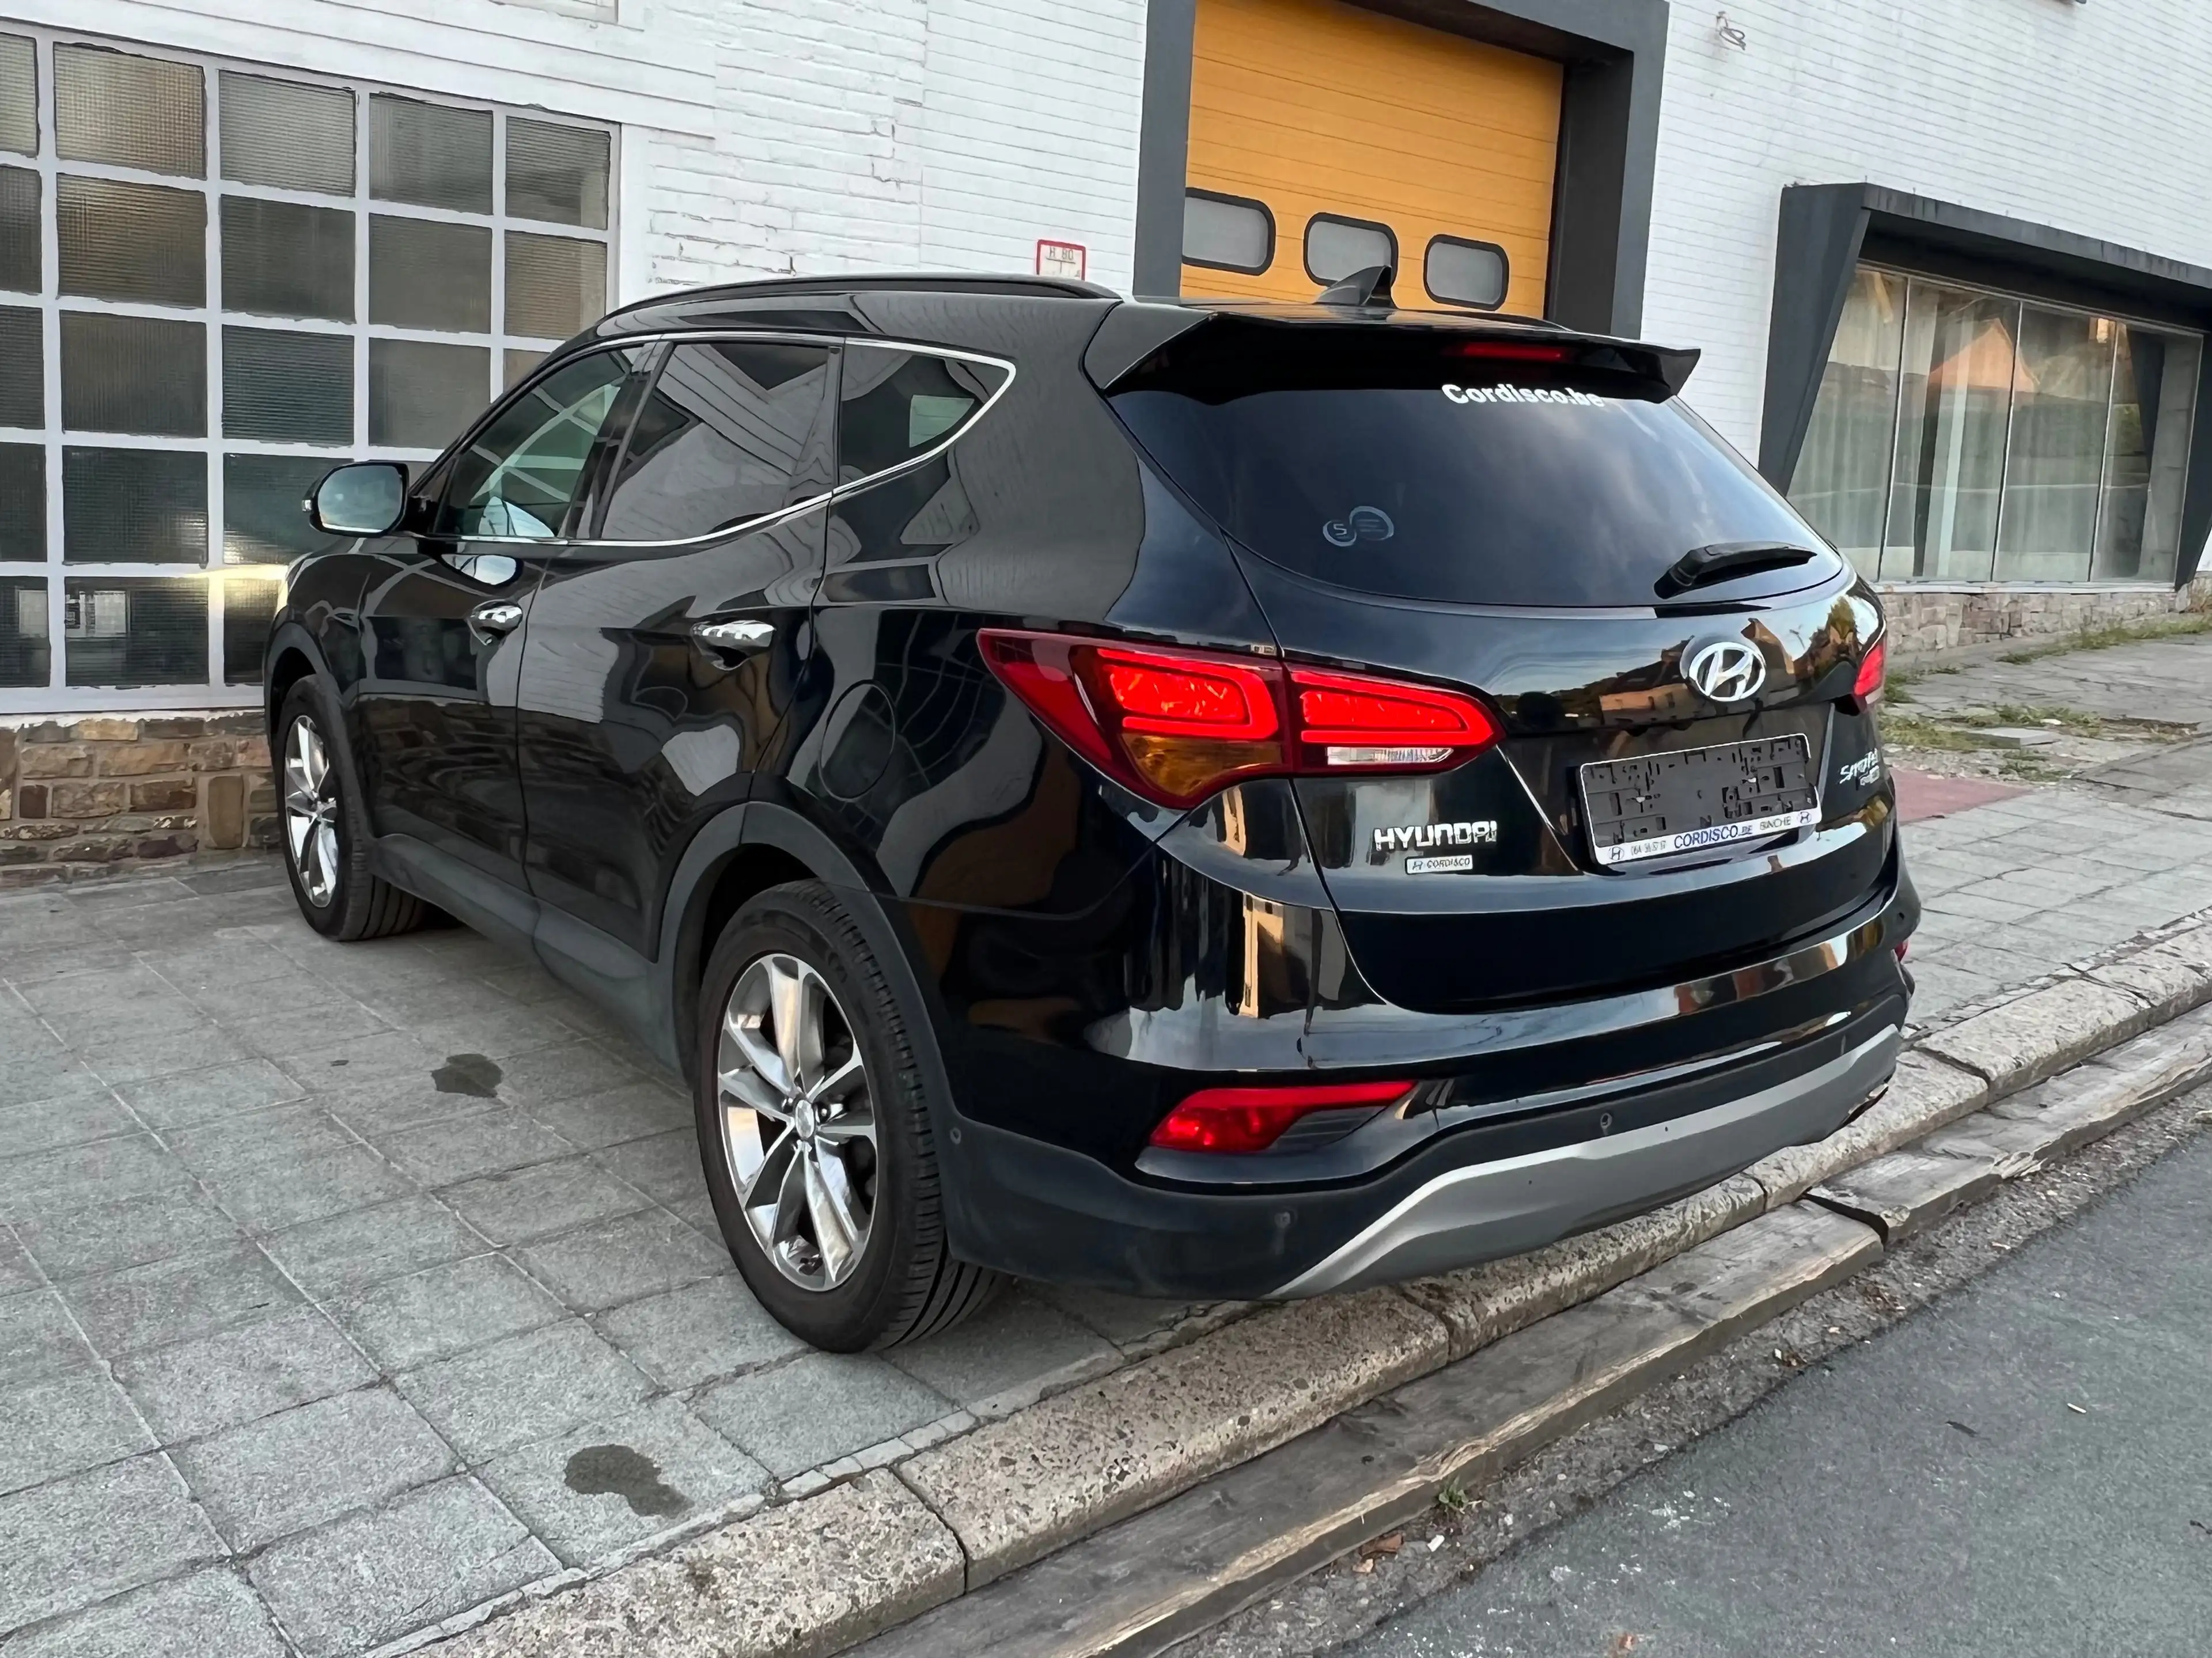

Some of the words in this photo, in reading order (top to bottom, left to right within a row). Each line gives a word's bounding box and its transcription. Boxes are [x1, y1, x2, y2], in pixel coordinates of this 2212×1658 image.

[1441, 384, 1605, 407] Cordisco.be
[1374, 821, 1498, 851] HYUNDAI
[1426, 858, 1471, 869] CORDISCO
